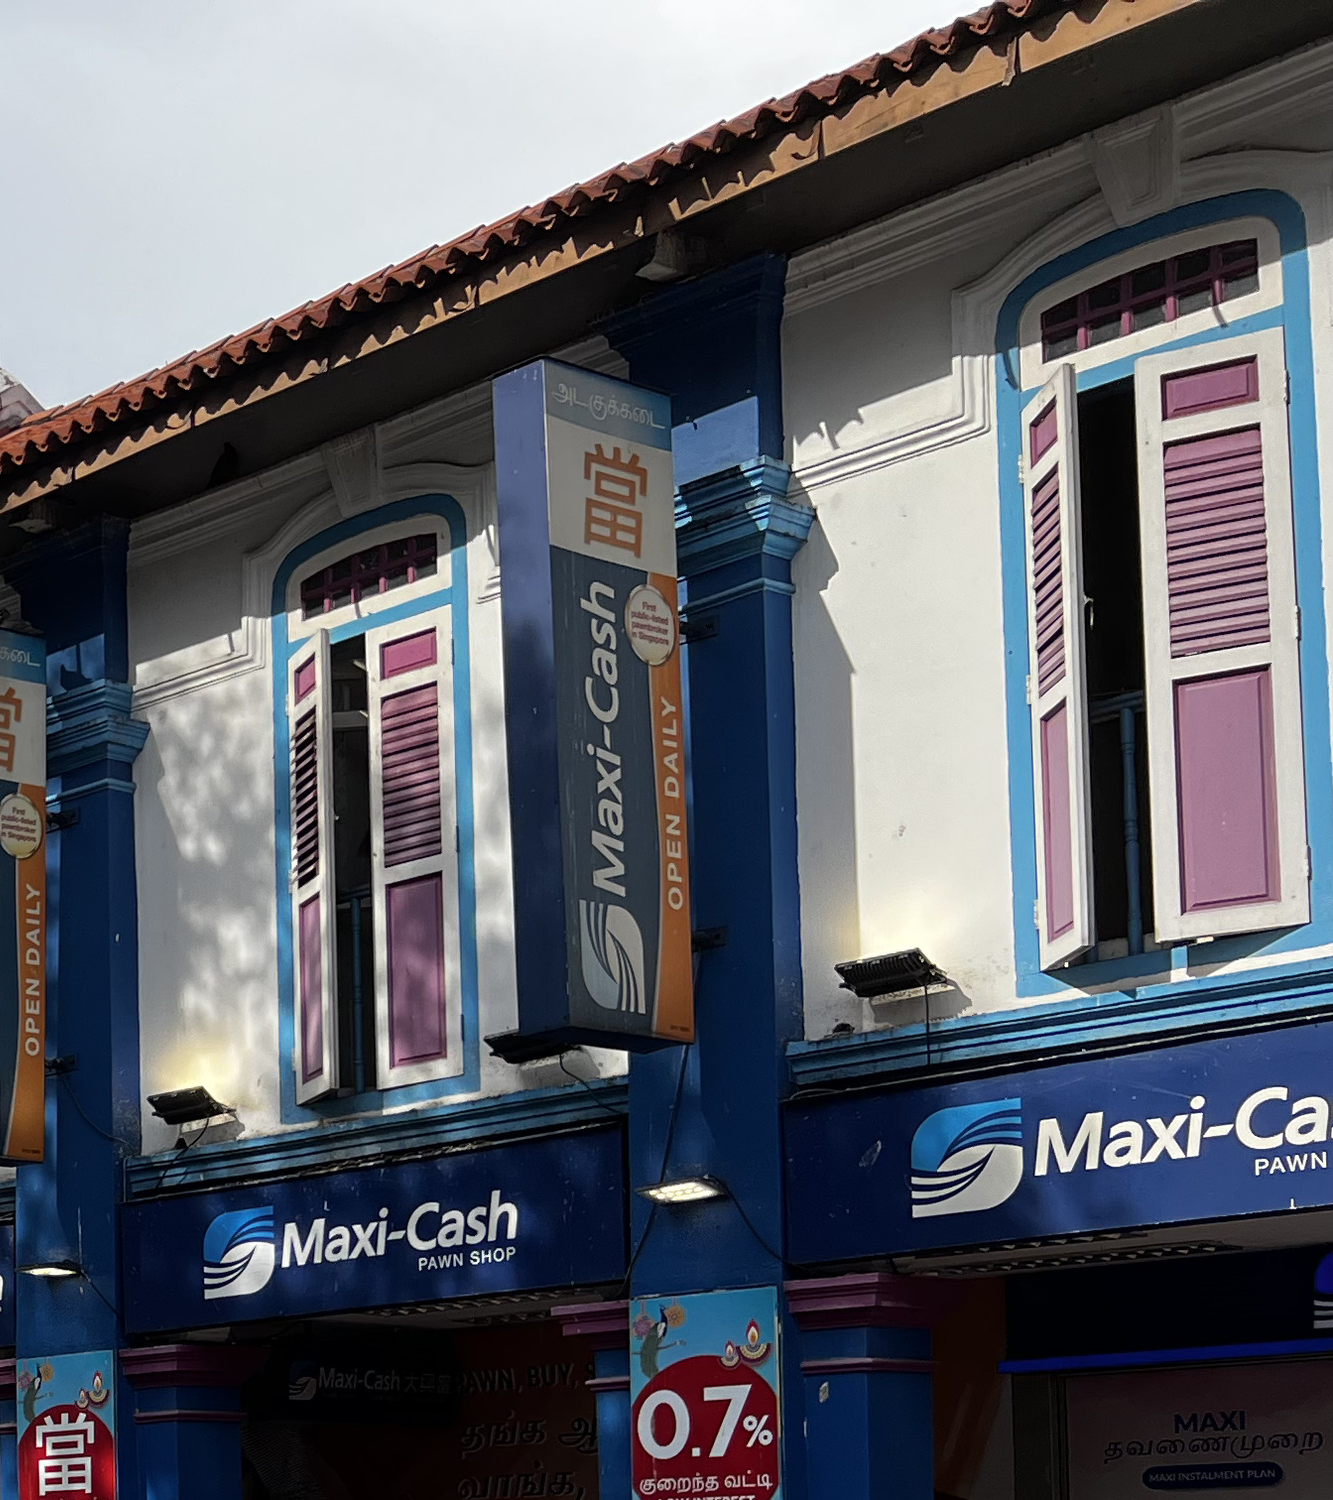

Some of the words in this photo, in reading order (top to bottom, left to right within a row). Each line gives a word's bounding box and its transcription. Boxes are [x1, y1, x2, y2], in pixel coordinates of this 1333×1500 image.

[581, 580, 626, 897] Maxi-Cash
[661, 695, 681, 798] DAILY
[664, 815, 684, 910] OPEN
[25, 884, 41, 961] DAILY
[25, 971, 40, 1057] OPEN
[1034, 1086, 1333, 1176] Maxi-Ca
[1254, 1151, 1328, 1176] PAWN
[281, 1191, 519, 1268] Maxi-Cash
[417, 1252, 465, 1272] PAWN
[469, 1247, 517, 1268] SHOP
[318, 1366, 401, 1392] Maxi-Cash
[637, 1384, 773, 1460] 0.7%
[1173, 1410, 1246, 1434] MAXI
[724, 1472, 773, 1491] வட்டி
[1148, 1472, 1177, 1482] MAXI
[1178, 1470, 1245, 1482] INSTALMENT
[1247, 1468, 1276, 1479] PLAN
